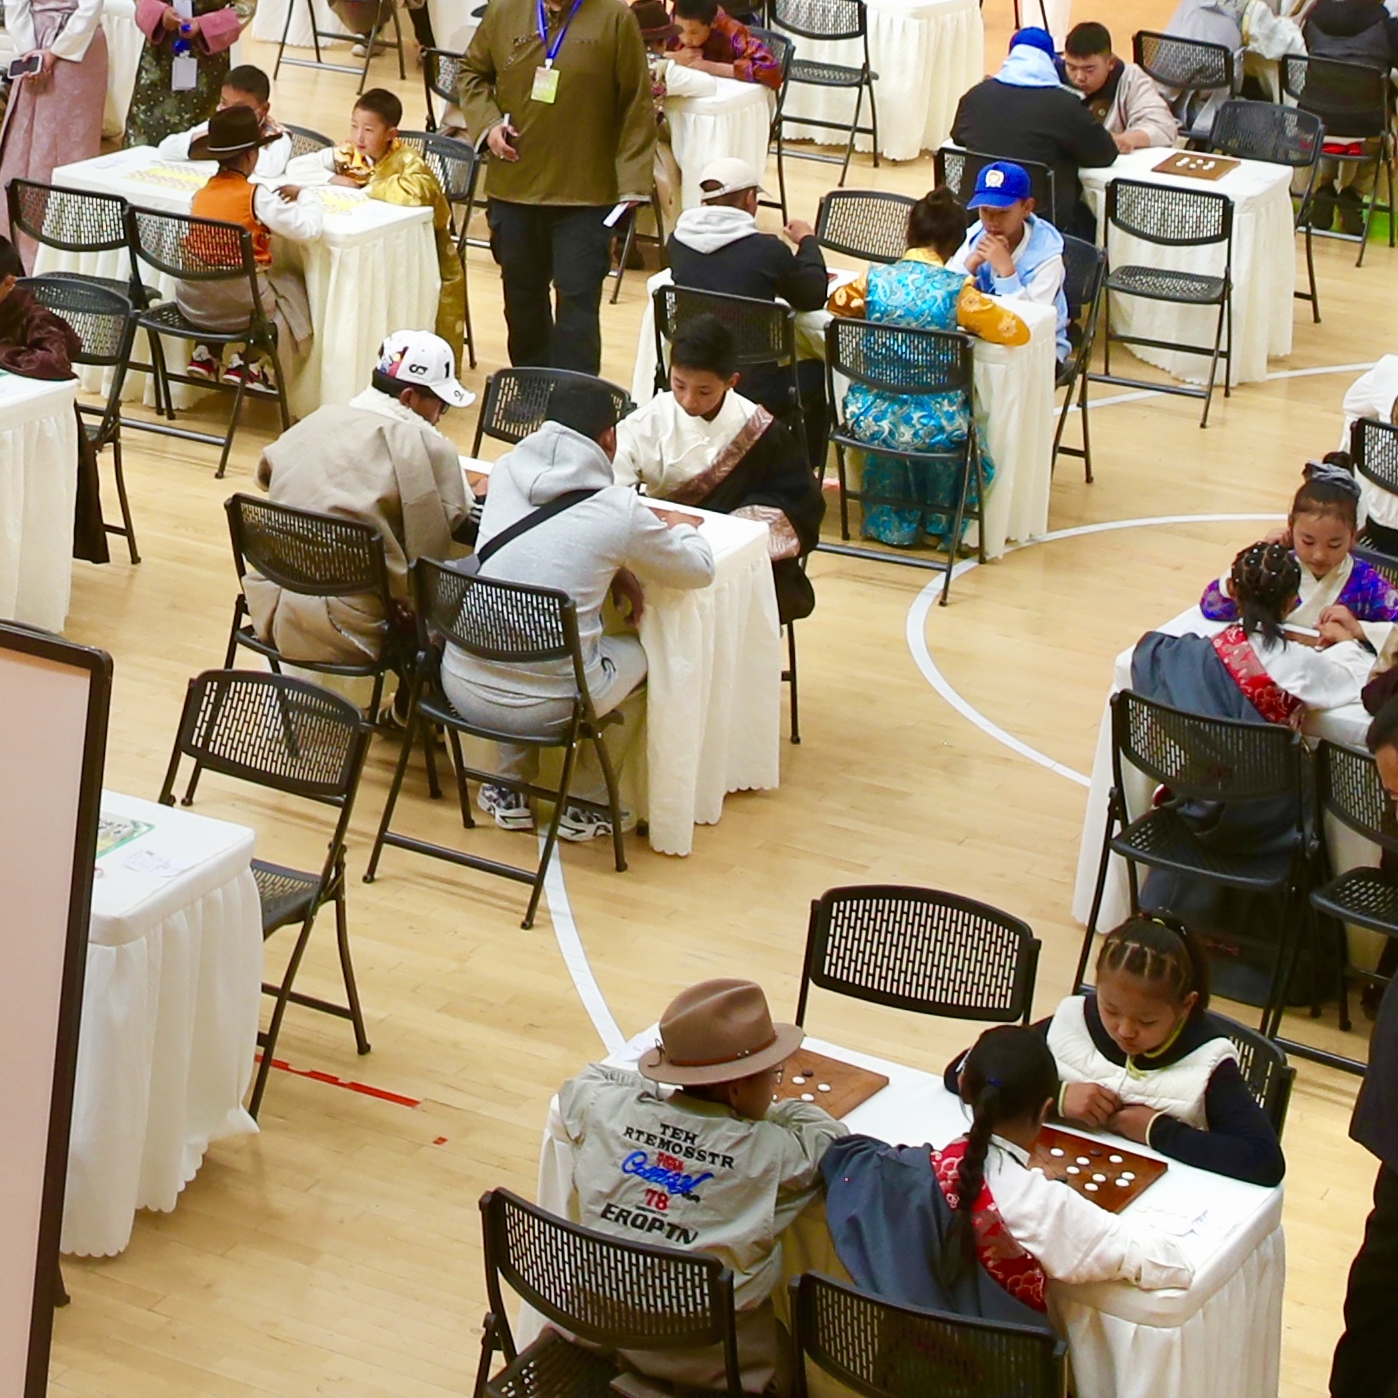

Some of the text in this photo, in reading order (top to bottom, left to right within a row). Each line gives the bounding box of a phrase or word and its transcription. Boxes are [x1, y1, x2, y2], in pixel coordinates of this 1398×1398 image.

[623, 1126, 735, 1169] RTEMOSSTR
[659, 1122, 699, 1145] TEH
[601, 1203, 700, 1245] EROPTN
